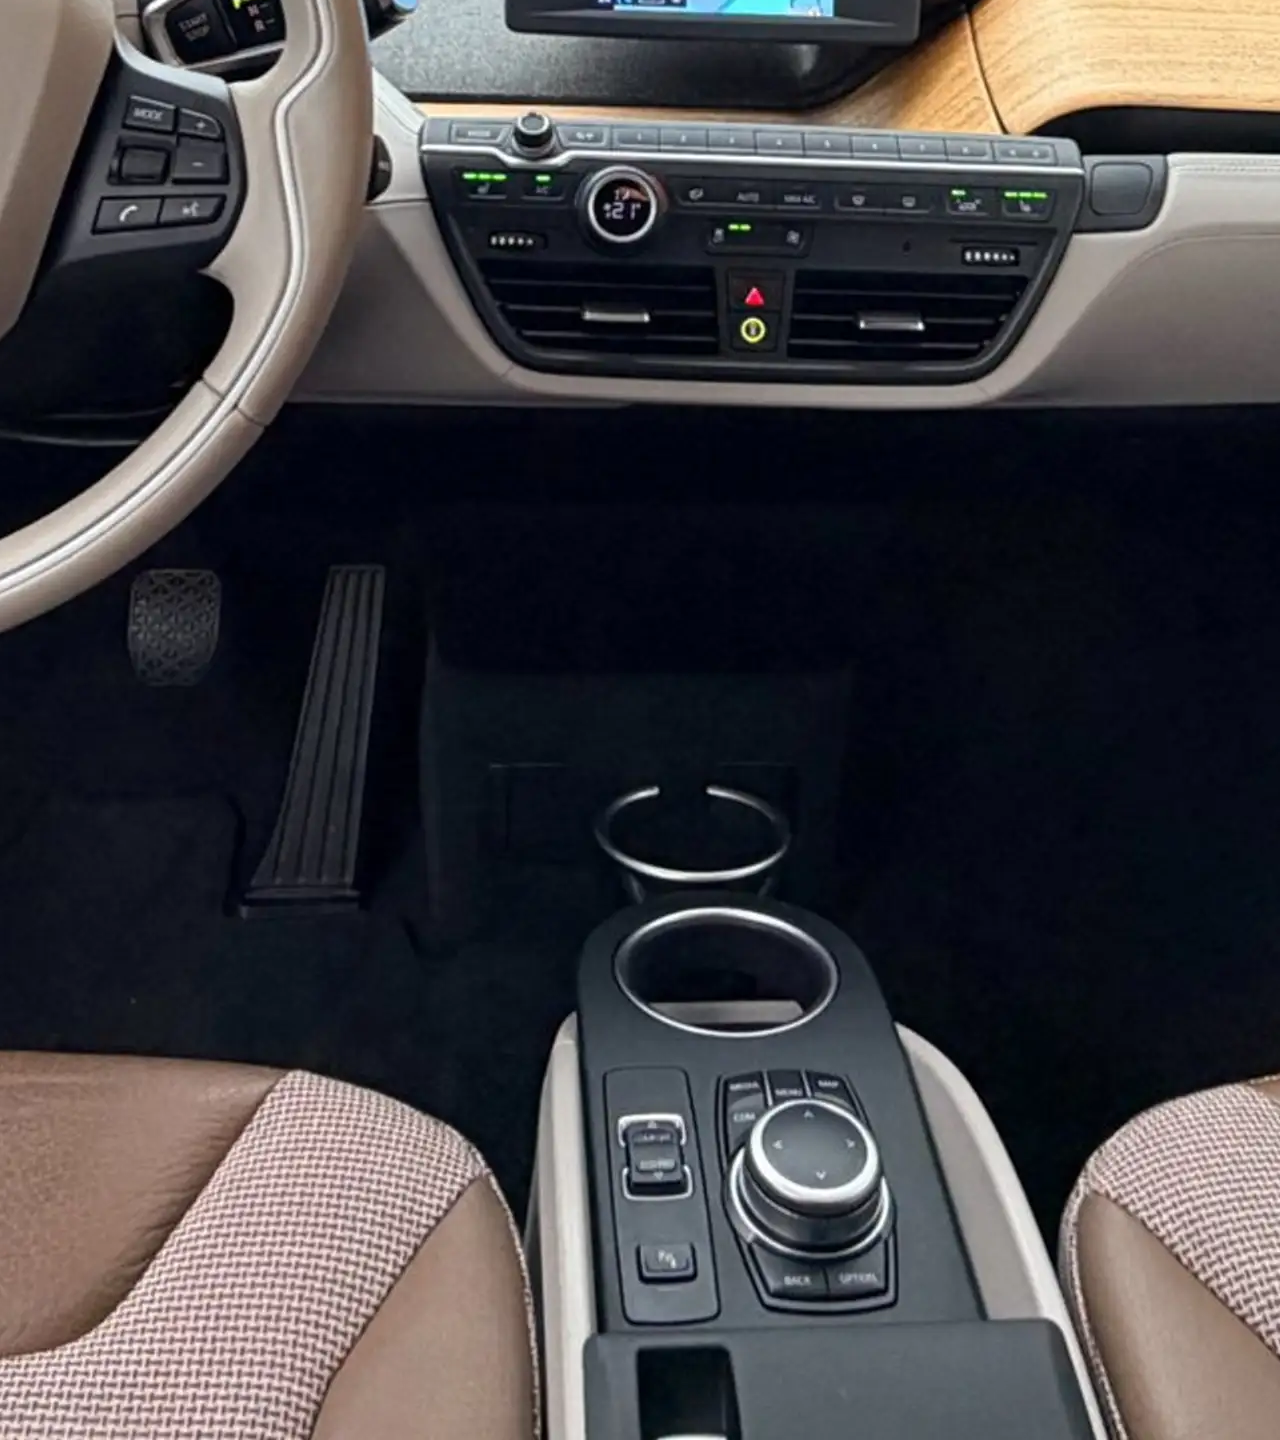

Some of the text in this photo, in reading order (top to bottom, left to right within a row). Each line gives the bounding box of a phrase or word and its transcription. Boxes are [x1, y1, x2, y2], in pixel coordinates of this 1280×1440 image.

[775, 1087, 803, 1098] MENU
[783, 1274, 812, 1286] BACK
[838, 1273, 878, 1285] OPTION
